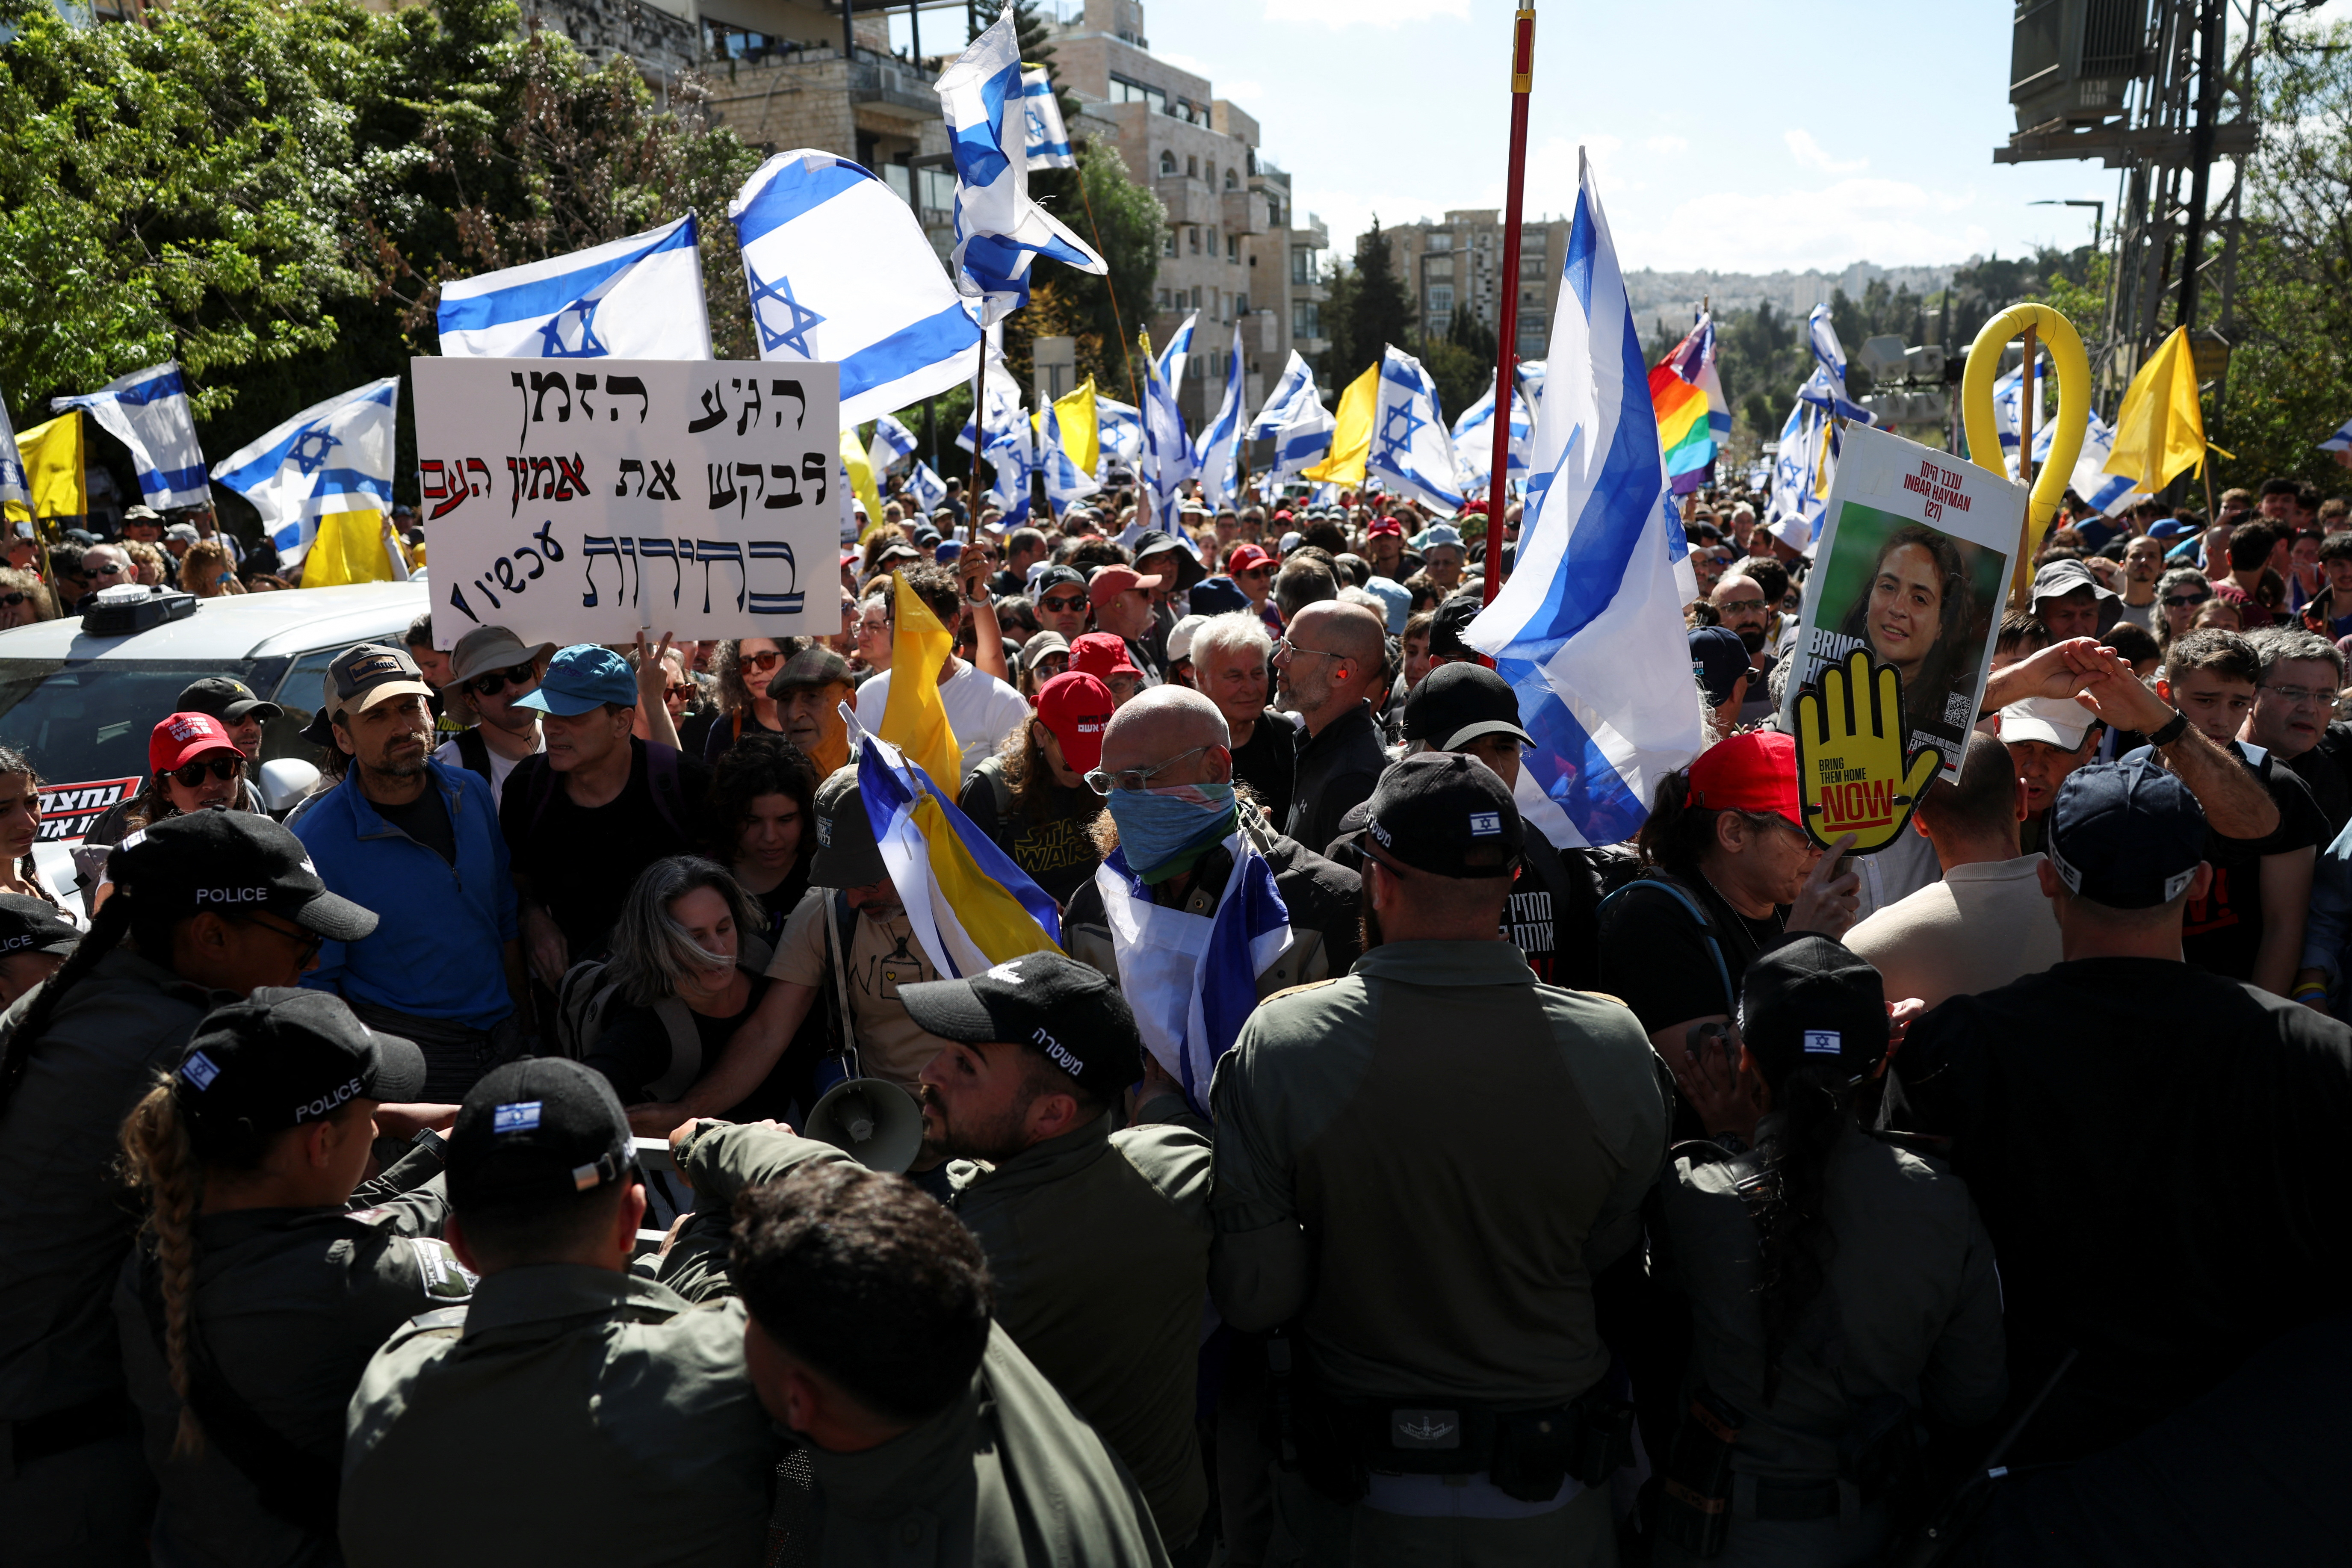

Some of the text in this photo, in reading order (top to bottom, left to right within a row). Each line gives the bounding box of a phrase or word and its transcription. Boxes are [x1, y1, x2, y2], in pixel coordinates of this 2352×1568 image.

[511, 371, 805, 454] הגיע הזמן
[420, 452, 826, 520] לבקש את אמון העם
[1920, 460, 1962, 490] ענבר הימן
[1903, 473, 1971, 512] INBAR HAYMAN
[1925, 499, 1942, 522] (27)
[583, 534, 805, 614] בחירות
[168, 720, 185, 731] END
[174, 726, 213, 742] WAR
[1078, 724, 1099, 732] אשם
[1912, 729, 1936, 744] HOSTAGES
[1935, 737, 1945, 748] AND
[1944, 740, 1961, 754] MISSING
[1819, 757, 1844, 771] BRING
[1820, 768, 1866, 784] THEM HOME
[1821, 779, 1894, 823] NOW
[1014, 818, 1078, 849] STA
[196, 887, 268, 905] POLICE
[1513, 922, 1555, 952] אותם
[1032, 1027, 1084, 1077] משטרה
[295, 1078, 363, 1124] POLICE
